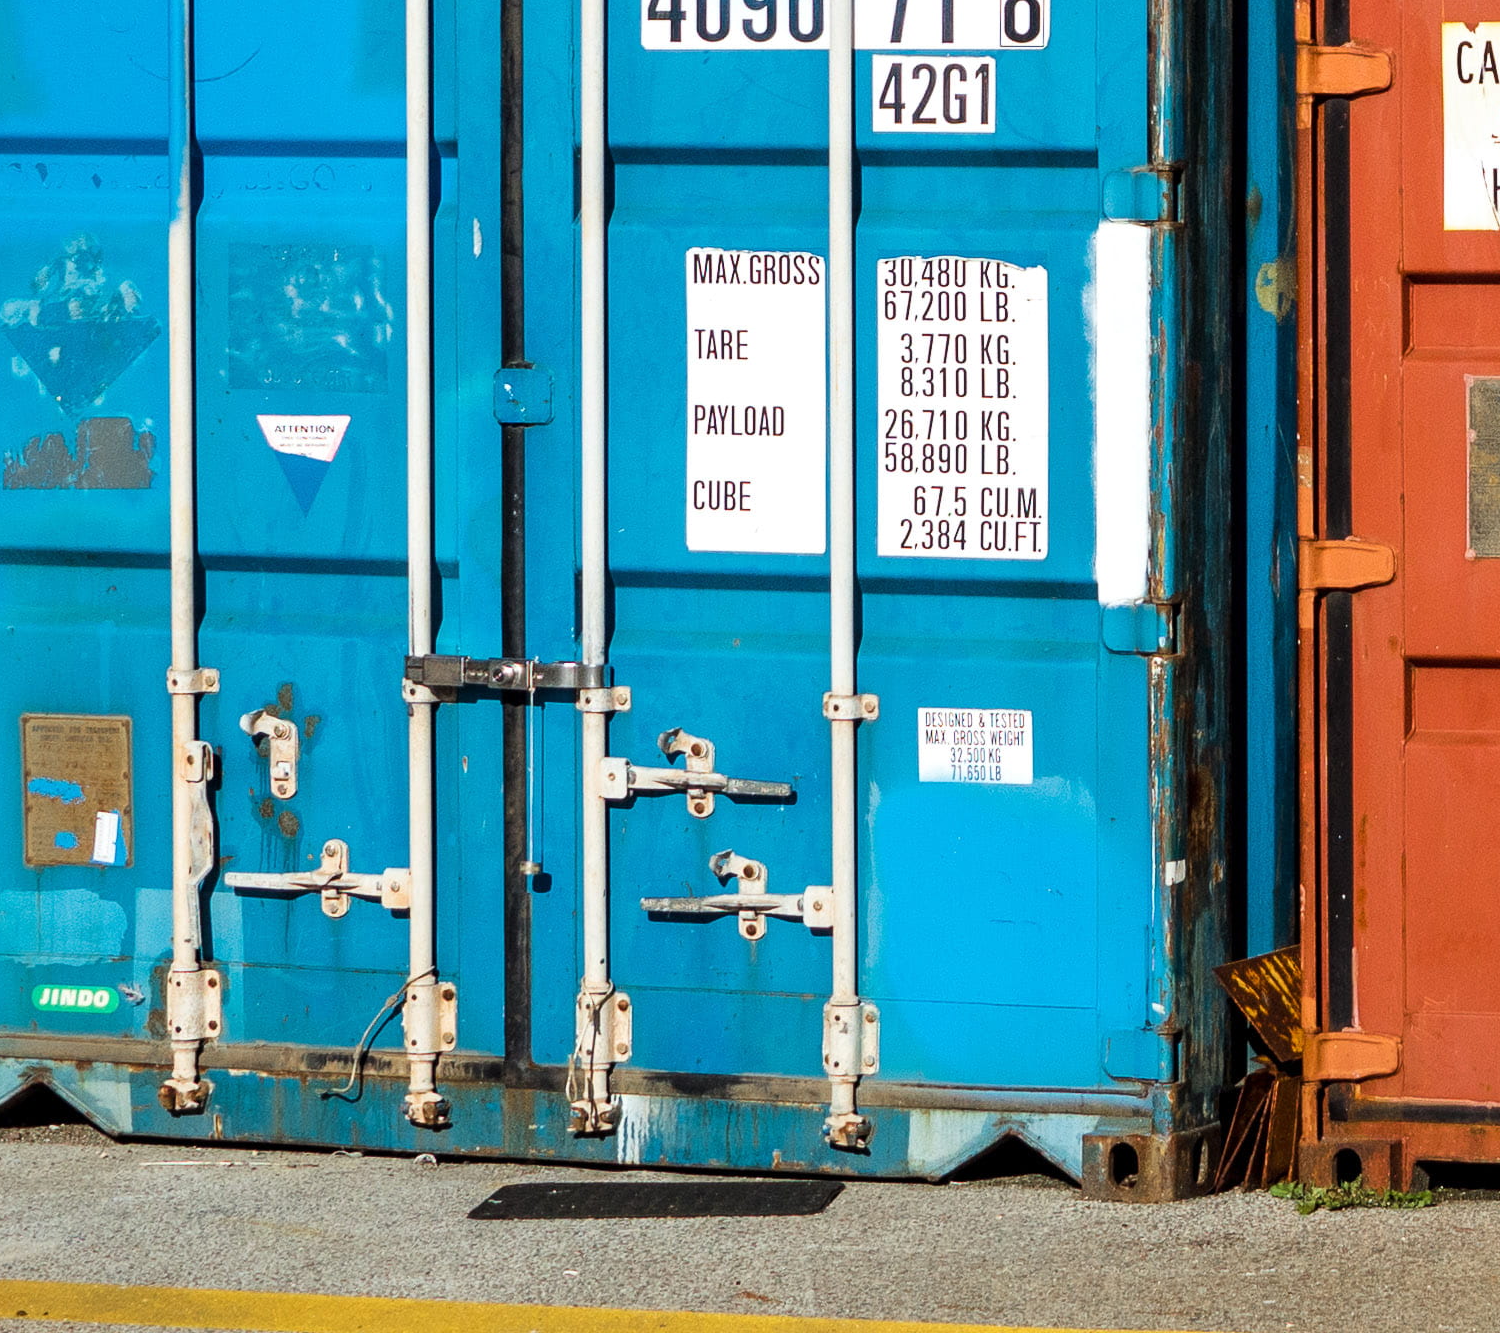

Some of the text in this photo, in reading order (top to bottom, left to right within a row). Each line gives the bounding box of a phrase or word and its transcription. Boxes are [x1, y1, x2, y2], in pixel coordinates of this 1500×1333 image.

[879, 62, 990, 125] 42G1
[883, 258, 1016, 289] 30,480 KG.
[884, 290, 1016, 323] 67,200 LB.
[694, 329, 749, 360] TARE
[900, 333, 1017, 366] 3,770 KG.
[900, 366, 1017, 399] 8,310 LB.
[274, 425, 335, 434] ATTENTION
[694, 404, 785, 437] PAYLOAD
[884, 409, 1017, 442] 26,710 KG.
[884, 442, 1017, 476] 58,890 LB.
[693, 480, 752, 512] CUBE
[913, 485, 1043, 519] 67.5 CU.M.
[900, 519, 1043, 553] 2,384 CU.FT.
[925, 712, 1025, 729] DESIGNED & TESTED
[925, 729, 1025, 746] MAX. GROSS WEIGHT
[988, 747, 1002, 764] KG
[952, 764, 1002, 782] 71,650 LB
[39, 987, 110, 1009] JINDO
